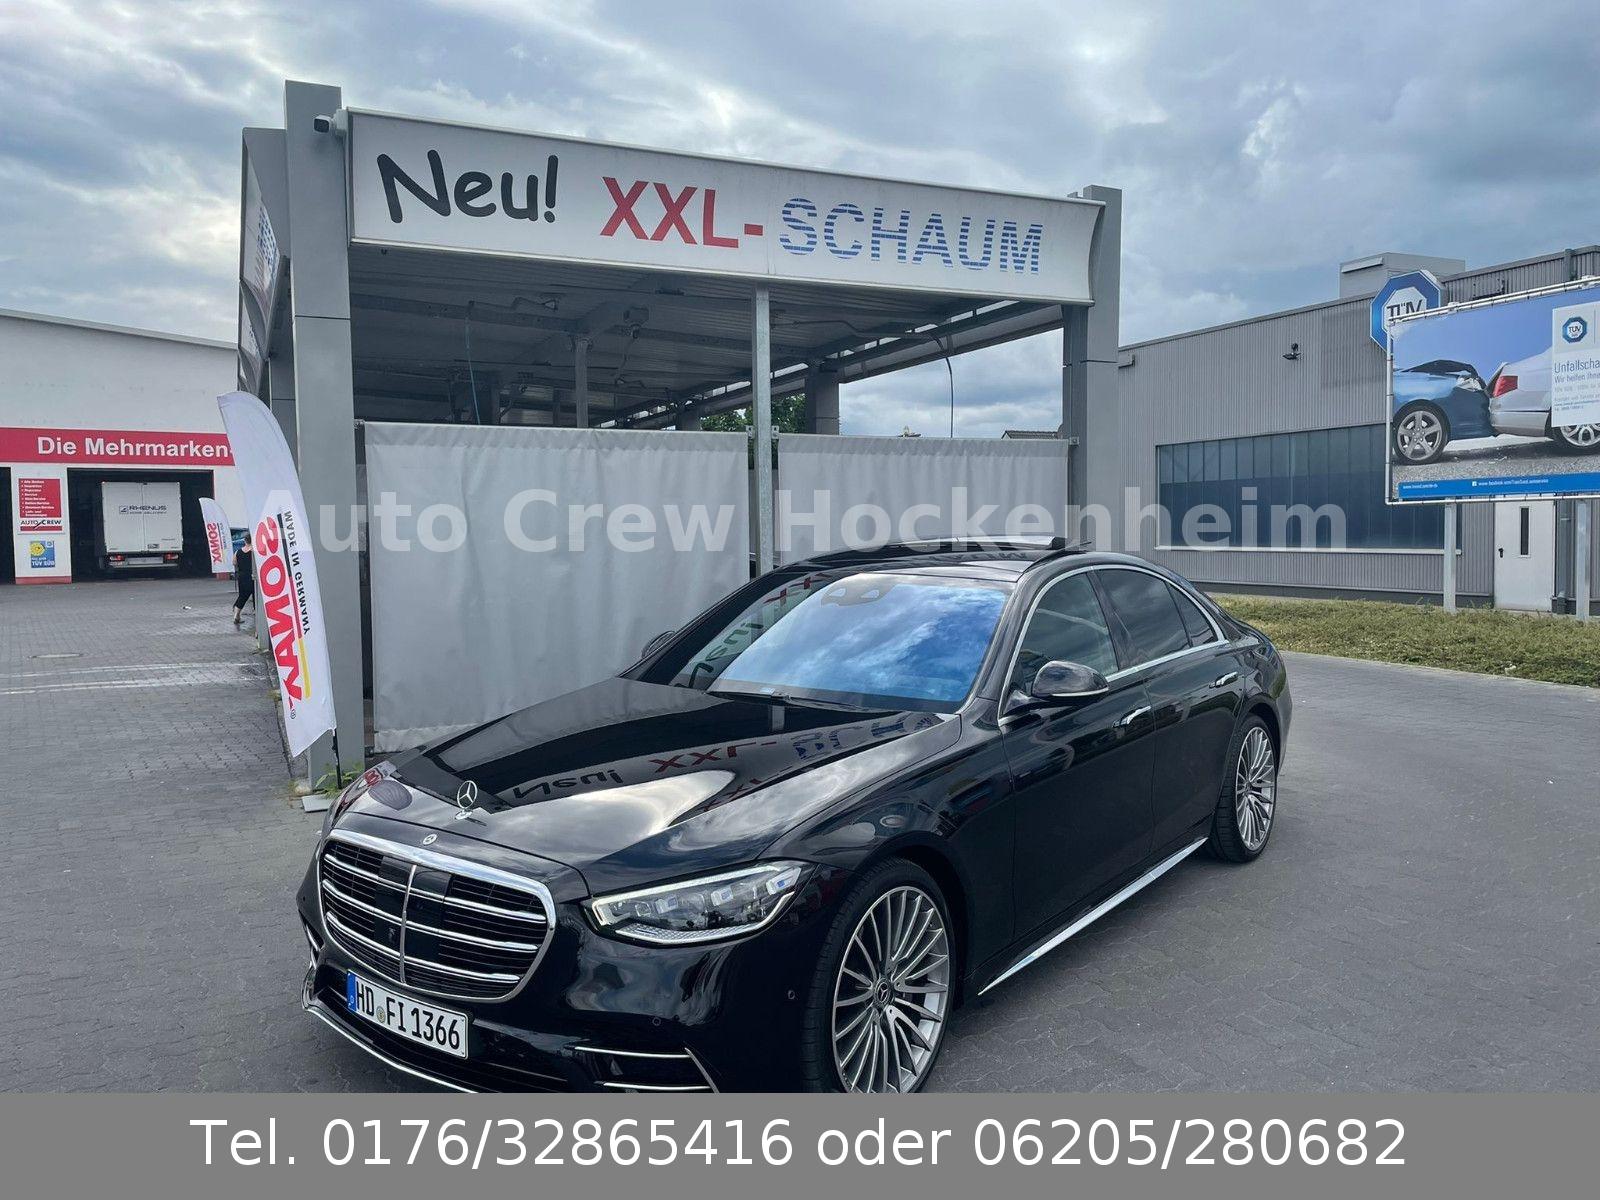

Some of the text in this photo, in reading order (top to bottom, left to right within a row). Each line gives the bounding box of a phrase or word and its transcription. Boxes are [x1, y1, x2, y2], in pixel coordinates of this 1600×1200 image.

[377, 149, 559, 224] Neu!
[37, 436, 77, 455] Die
[356, 981, 460, 1050] HD FI 1366
